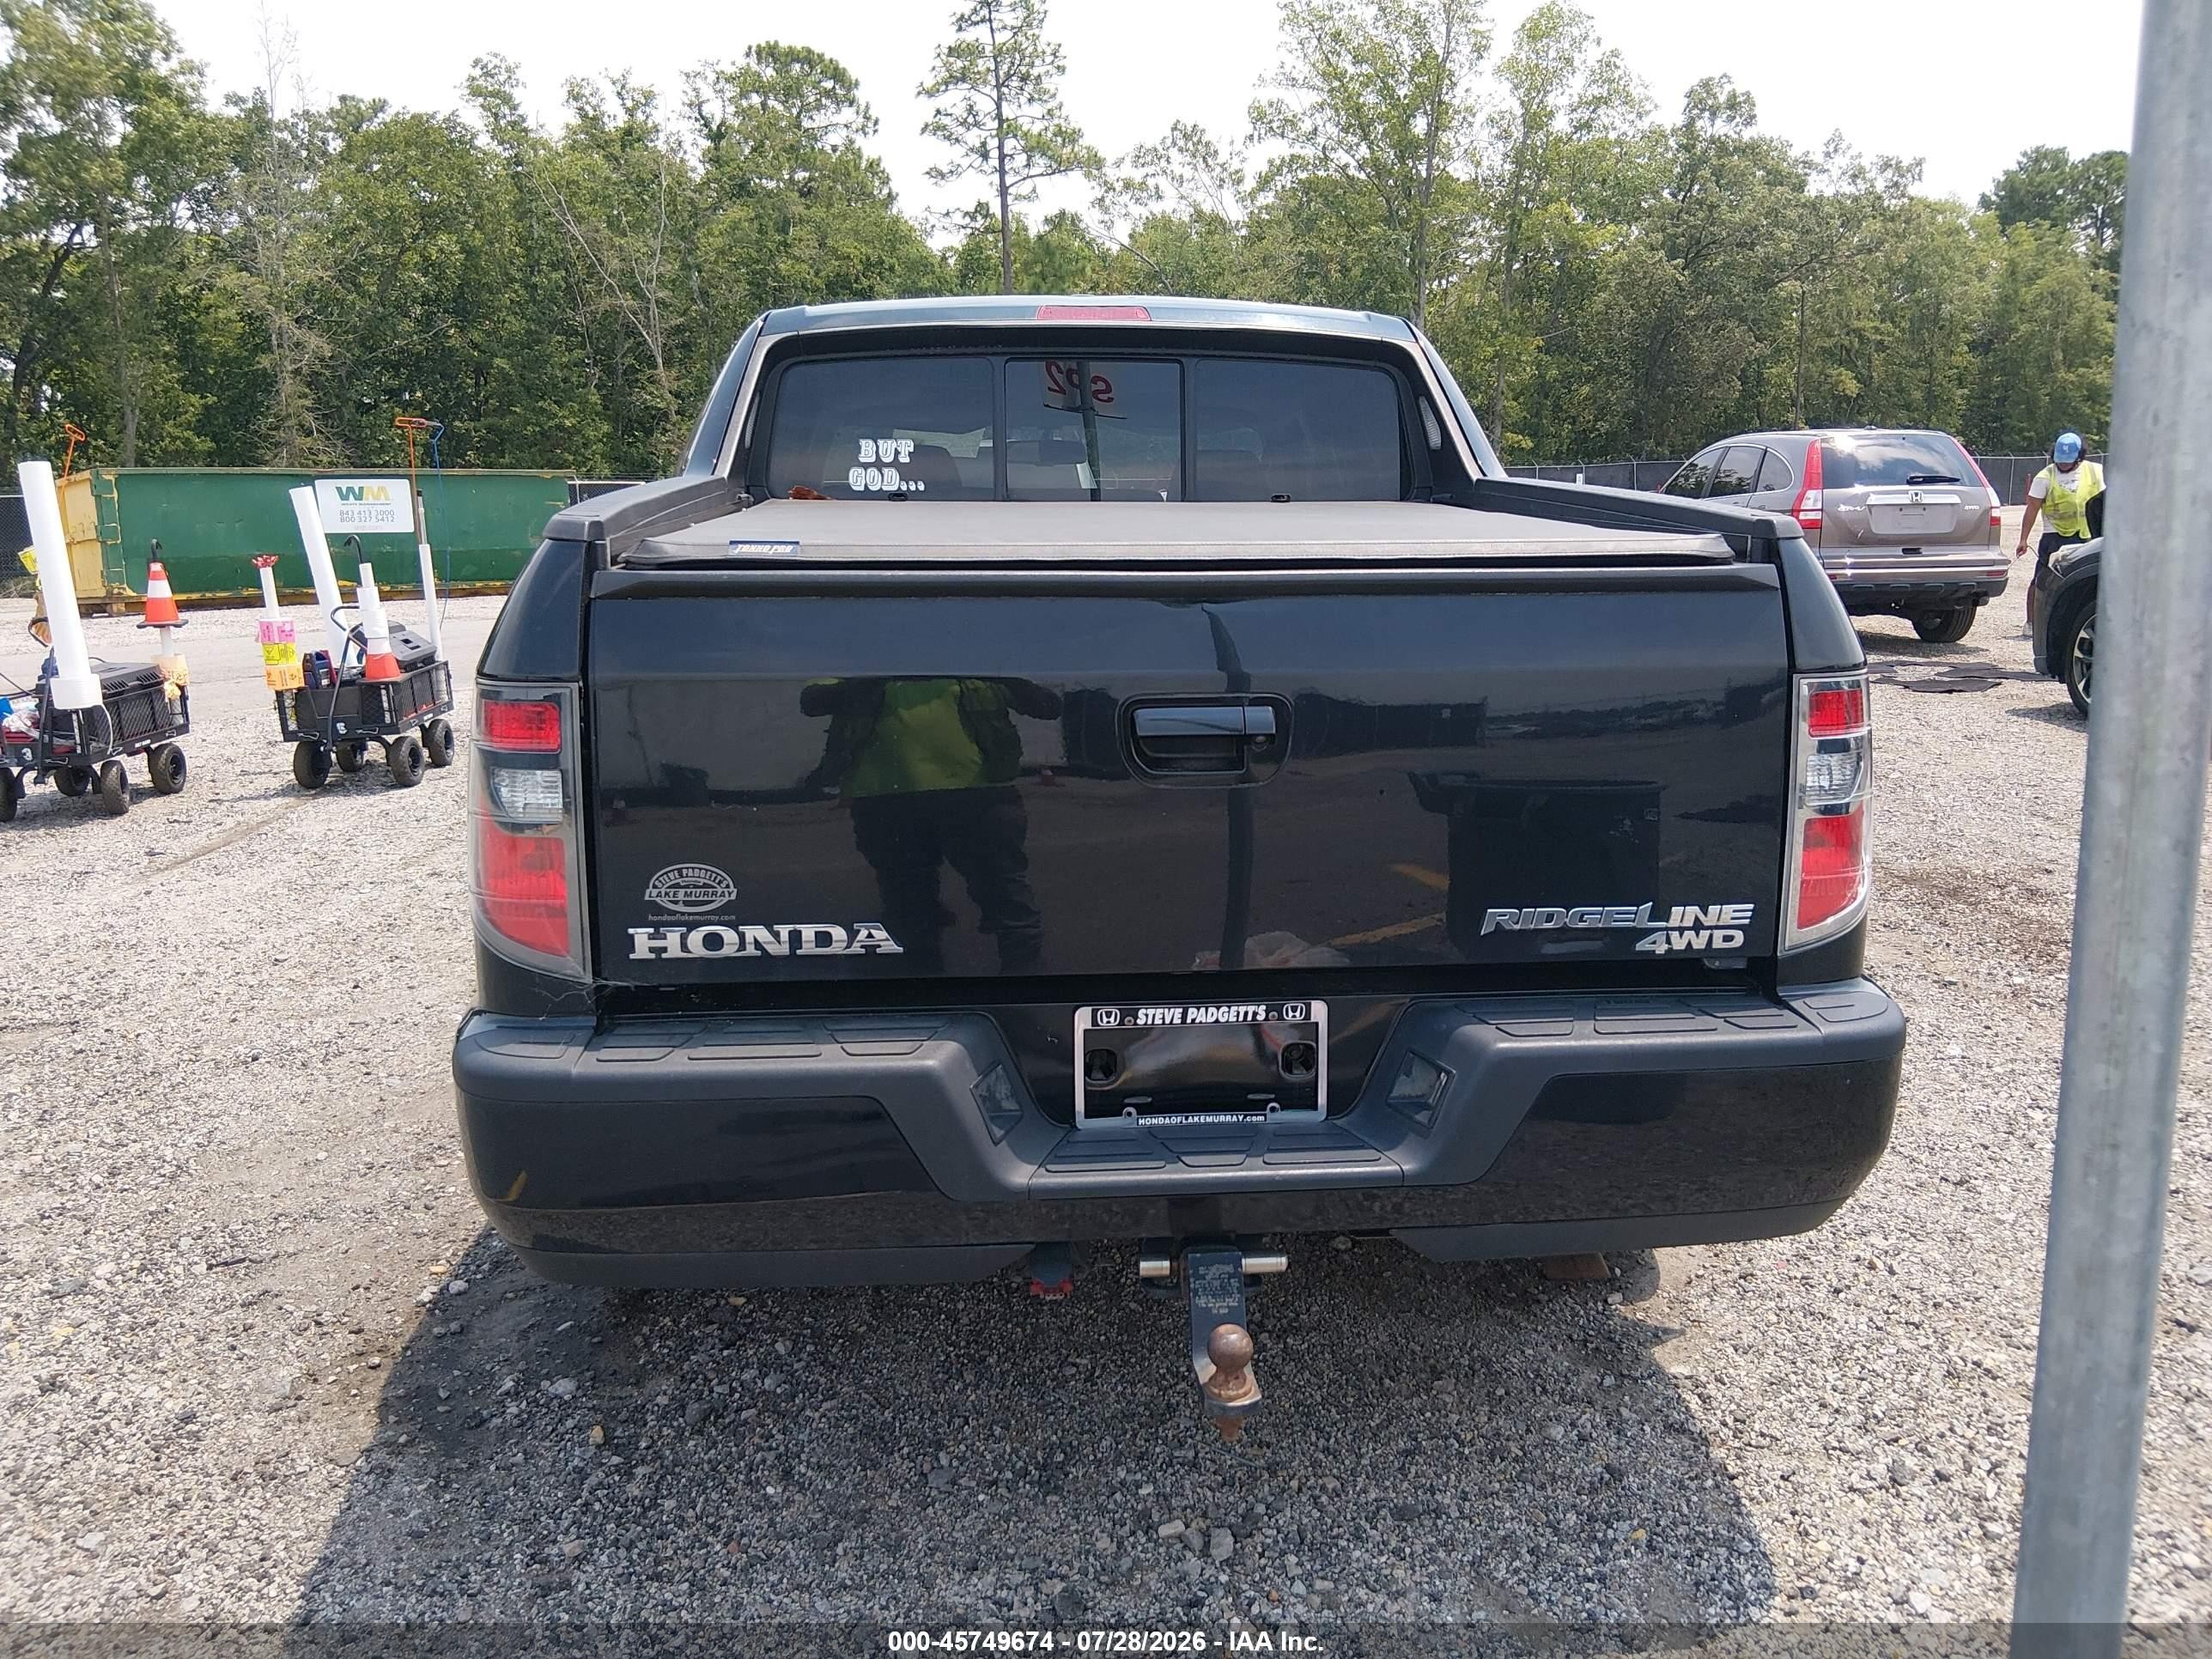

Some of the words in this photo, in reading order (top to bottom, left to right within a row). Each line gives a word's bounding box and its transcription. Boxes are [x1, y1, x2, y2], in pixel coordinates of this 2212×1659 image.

[858, 438, 915, 464] BUT
[848, 466, 926, 491] GOD...
[335, 486, 391, 501] WM
[654, 870, 680, 889] STEVE
[683, 868, 729, 888] PADGETT'S
[648, 890, 680, 899] LAKE
[683, 890, 734, 899] MURRAY
[647, 913, 736, 922] hondaoflakemurray.com
[1480, 902, 1754, 936] RIDGELINE
[628, 923, 904, 959] HONDA
[1635, 929, 1745, 954] 4WD
[1136, 1007, 1183, 1025] STEVE
[1186, 1005, 1267, 1024] PADGETT'S
[1138, 1114, 1265, 1126] HONDAOFLAKEMURRAY.com
